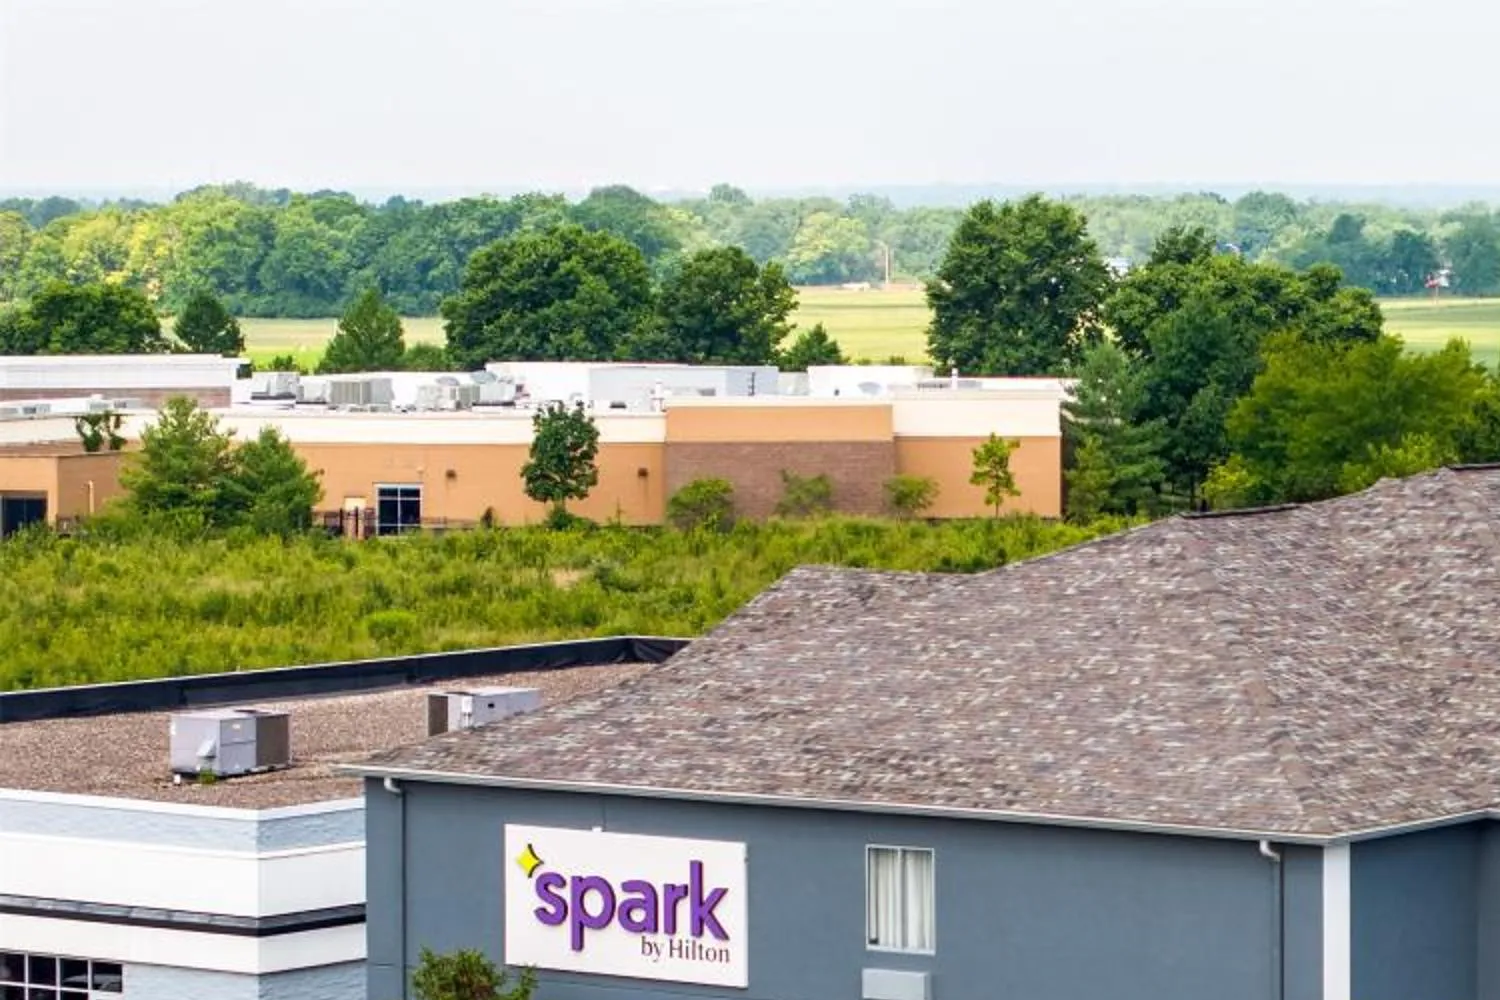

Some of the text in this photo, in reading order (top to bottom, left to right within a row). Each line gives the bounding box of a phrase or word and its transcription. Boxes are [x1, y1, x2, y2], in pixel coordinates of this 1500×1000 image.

[534, 860, 729, 951] spark
[641, 936, 730, 963] by Hilton
